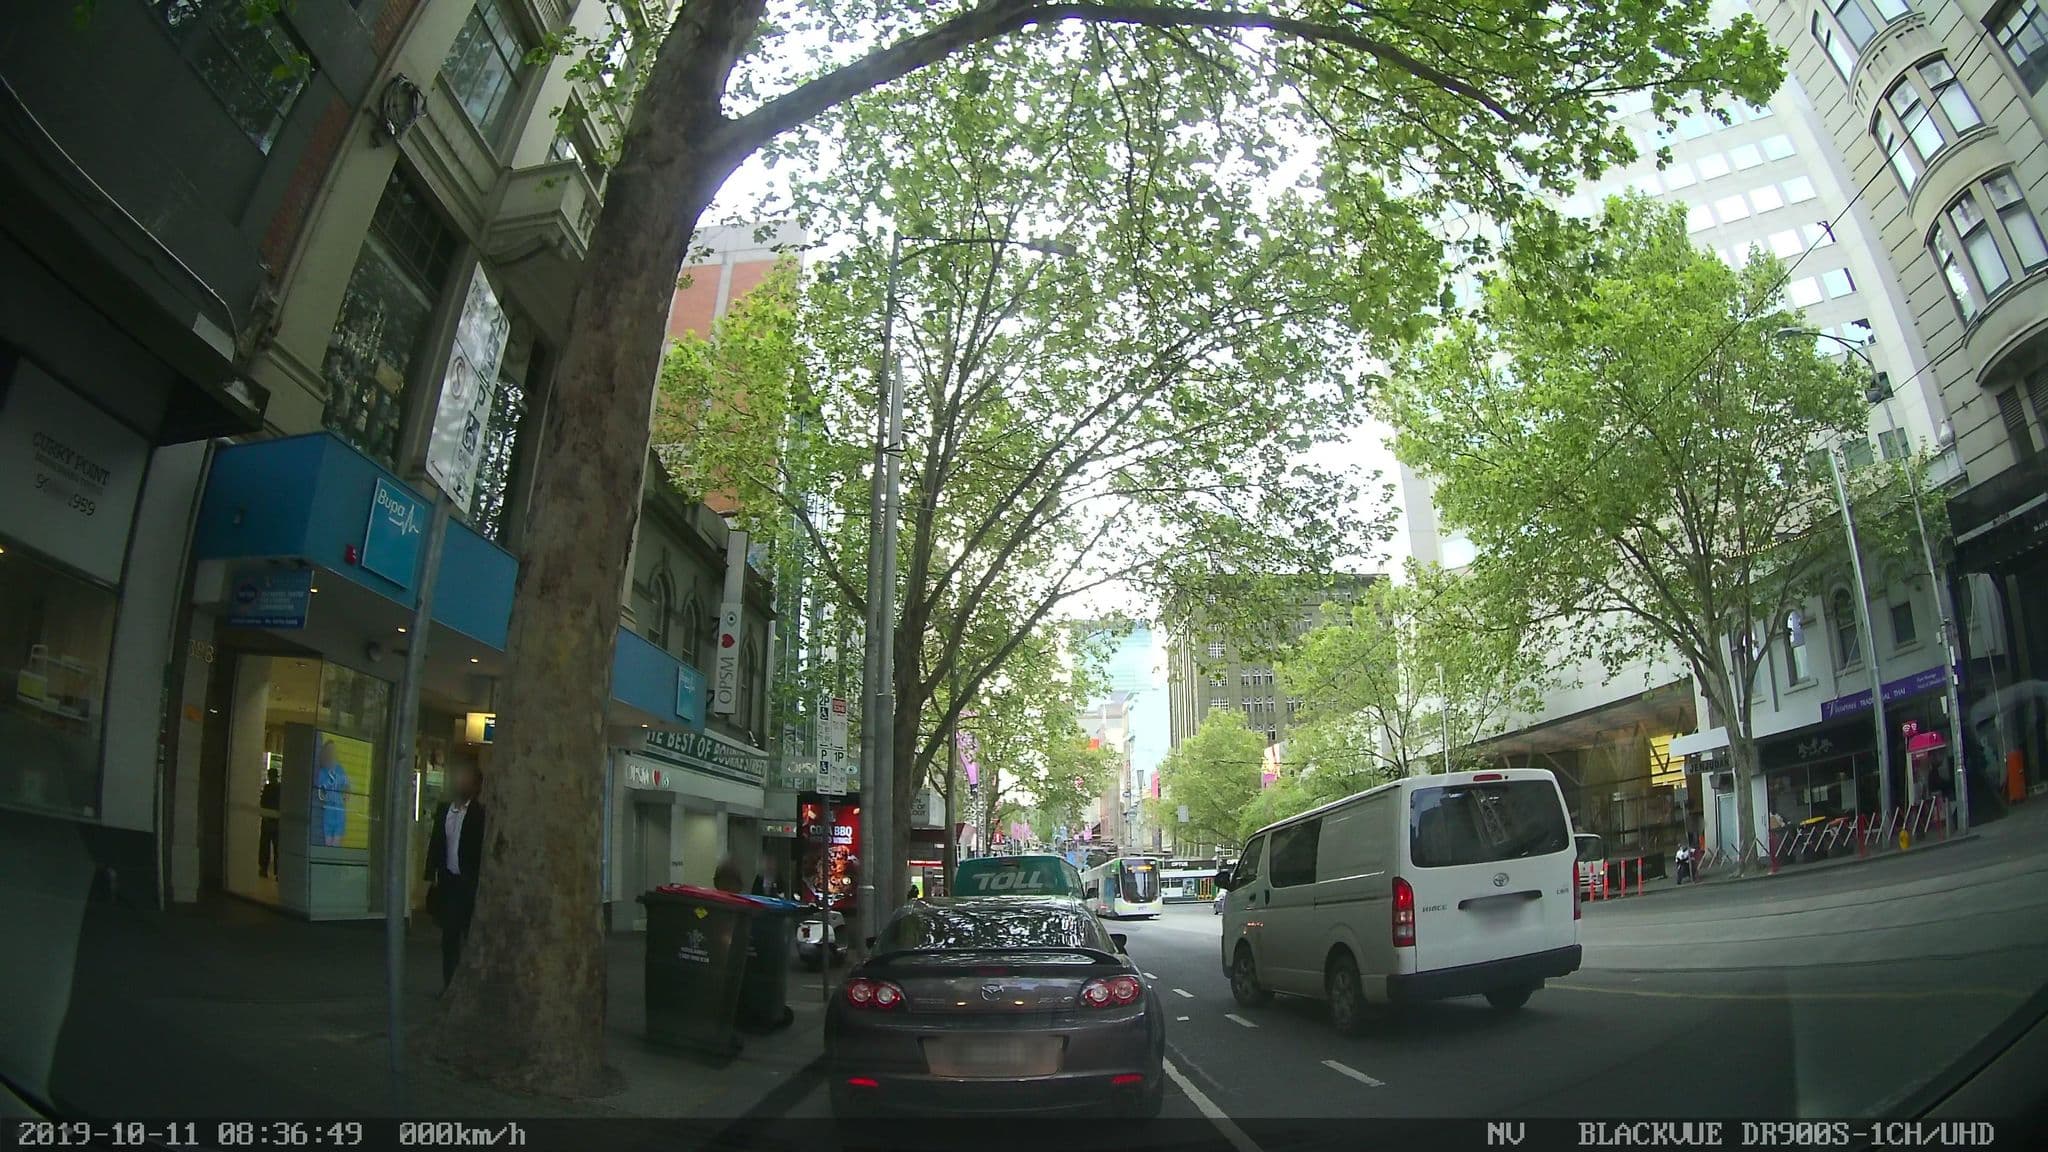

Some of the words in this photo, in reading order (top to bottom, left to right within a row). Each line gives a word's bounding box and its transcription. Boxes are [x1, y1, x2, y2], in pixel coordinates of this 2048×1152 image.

[74, 456, 111, 486] POINT
[377, 488, 406, 517] Bupa
[719, 657, 735, 704] OPSM
[819, 695, 830, 706] 2P
[668, 733, 695, 753] BEST
[697, 738, 712, 759] OF
[834, 752, 844, 763] 1P
[834, 826, 853, 838] BBQ
[972, 870, 1044, 891] TOLL
